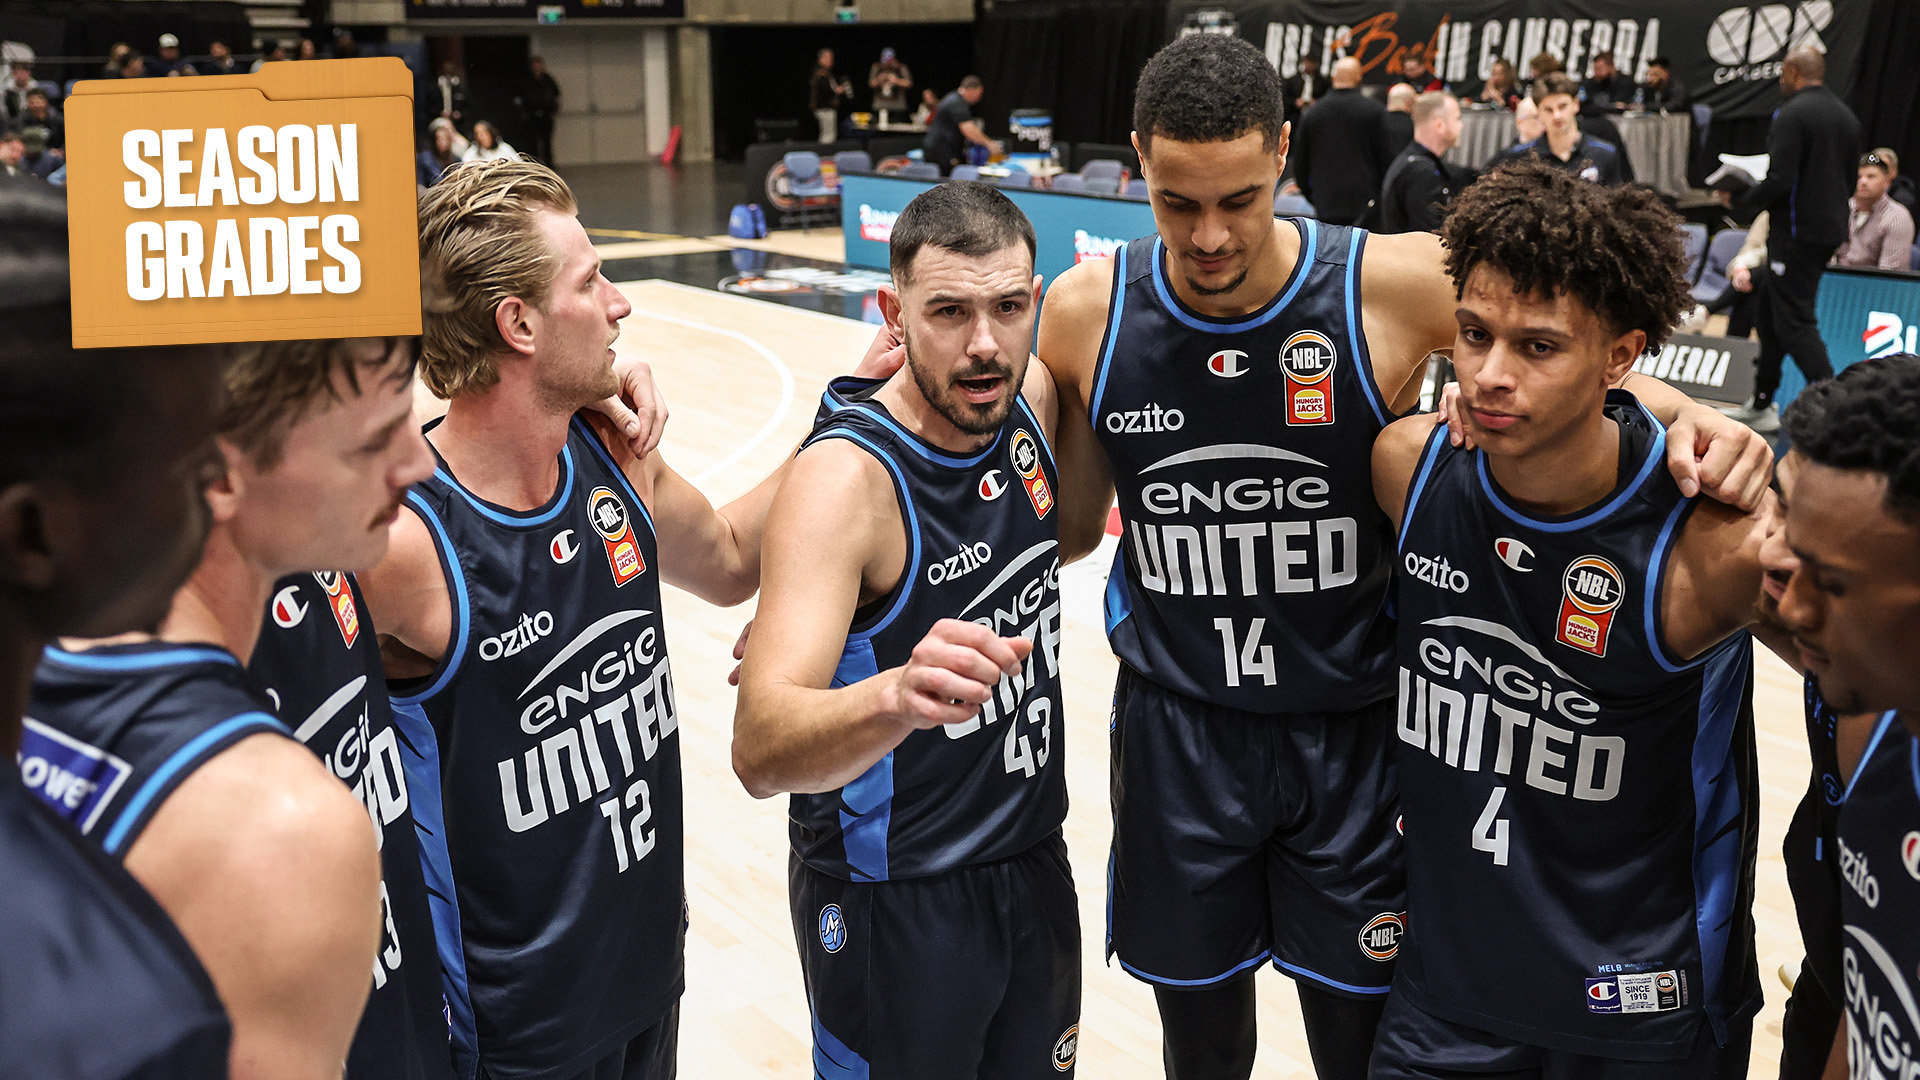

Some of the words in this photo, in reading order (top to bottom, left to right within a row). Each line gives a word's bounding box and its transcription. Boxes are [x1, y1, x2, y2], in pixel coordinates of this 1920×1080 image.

[1477, 17, 1661, 83] CANBERRA
[1292, 347, 1324, 370] NBL
[1016, 441, 1035, 470] NBL
[596, 501, 623, 530] NBL
[1130, 516, 1358, 597] UNITED
[1575, 569, 1610, 601] NBL
[1568, 621, 1597, 635] HUNGRY
[1213, 617, 1278, 687] 14
[497, 655, 679, 834] UNITED
[1004, 696, 1051, 779] 43
[1397, 665, 1626, 802] UNITED
[599, 779, 657, 874] 12
[1471, 786, 1510, 866] 4
[1371, 927, 1396, 947] NBL
[1598, 964, 1623, 973] MELB
[1625, 985, 1651, 994] SINCE
[1629, 993, 1648, 1001] 1919
